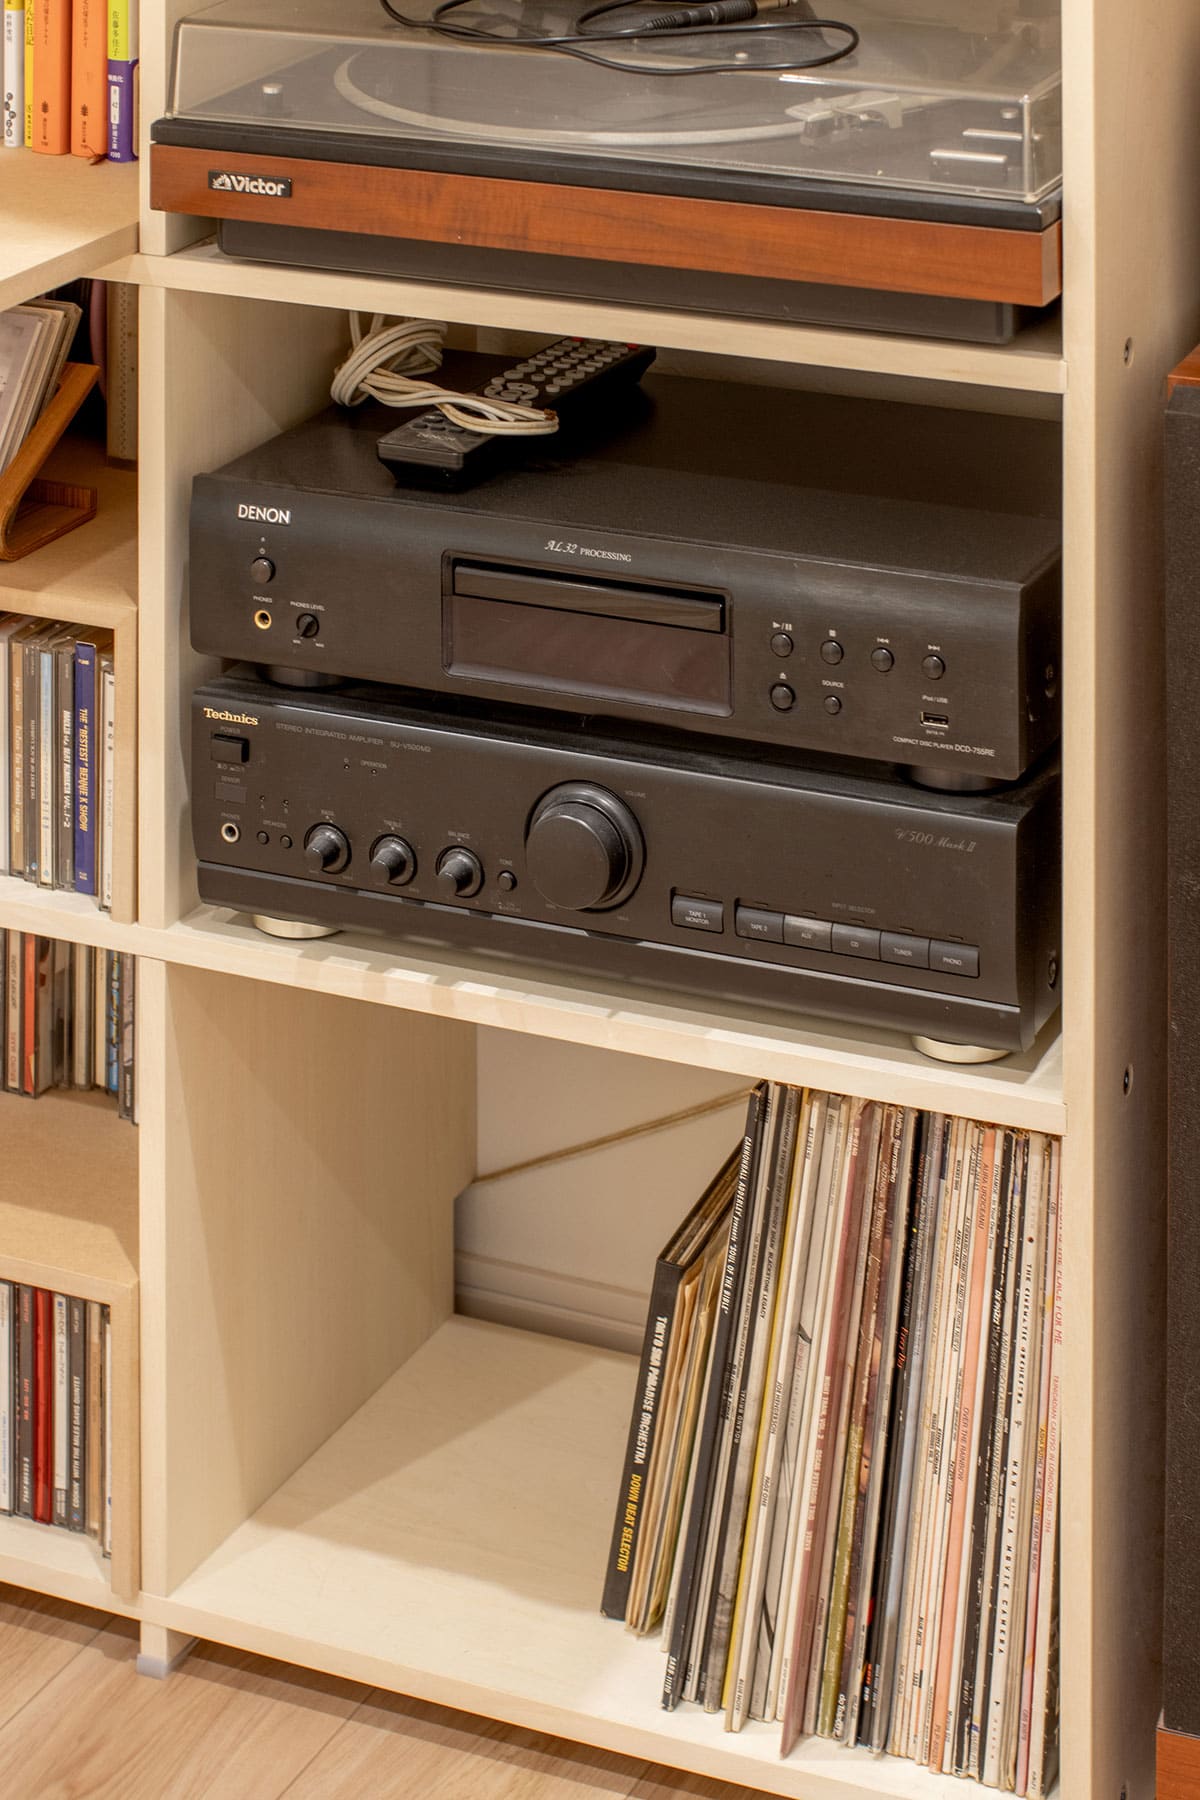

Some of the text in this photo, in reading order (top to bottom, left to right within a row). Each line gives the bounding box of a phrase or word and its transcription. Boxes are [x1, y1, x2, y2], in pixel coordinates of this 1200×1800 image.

[230, 176, 286, 197] Victor
[237, 504, 291, 525] DENON
[580, 547, 632, 563] PROCESSING
[252, 595, 273, 604] PHONES
[821, 679, 845, 689] SOURCE
[79, 707, 87, 723] THE
[203, 707, 259, 727] Technics
[275, 722, 303, 733] STEREO
[304, 726, 347, 741] INTEGRATED
[348, 734, 385, 747] AMPLIFIER
[892, 735, 918, 746] COMPACT
[78, 766, 88, 795] BENNIE
[942, 957, 963, 966] PHONO
[738, 1135, 753, 1180] CANNONBALL
[980, 1161, 990, 1184] AURA
[733, 1180, 747, 1217] ADDERLEY
[762, 1251, 774, 1292] BLACKSTONE
[1054, 1269, 1063, 1301] PLACE
[759, 1293, 769, 1319] LEGACY
[1054, 1305, 1062, 1326] FOR
[1014, 1262, 1033, 1405] THE CINEMATIC ORCHESTRA
[1053, 1328, 1062, 1345] ME
[72, 1375, 80, 1404] QUINTET
[633, 1314, 667, 1465] TOKYO SKA PARADISE ORCHESTRA
[1049, 1374, 1060, 1420] TRINIDADIAN
[72, 1405, 80, 1425] DAVIS
[768, 1381, 784, 1434] JOE HENDERSON
[72, 1425, 80, 1446] MILES
[956, 1406, 970, 1481] OVER THE RAINBOW
[1048, 1419, 1057, 1452] CALYPSO
[72, 1446, 80, 1459] THE
[813, 1448, 823, 1471] OSCAR
[72, 1460, 80, 1478] WITH
[1008, 1459, 1020, 1487] MAN
[615, 1473, 642, 1572] DOWN BEAT SELECTOR
[1001, 1544, 1014, 1589] MOVIE
[995, 1598, 1009, 1655] CAMERA
